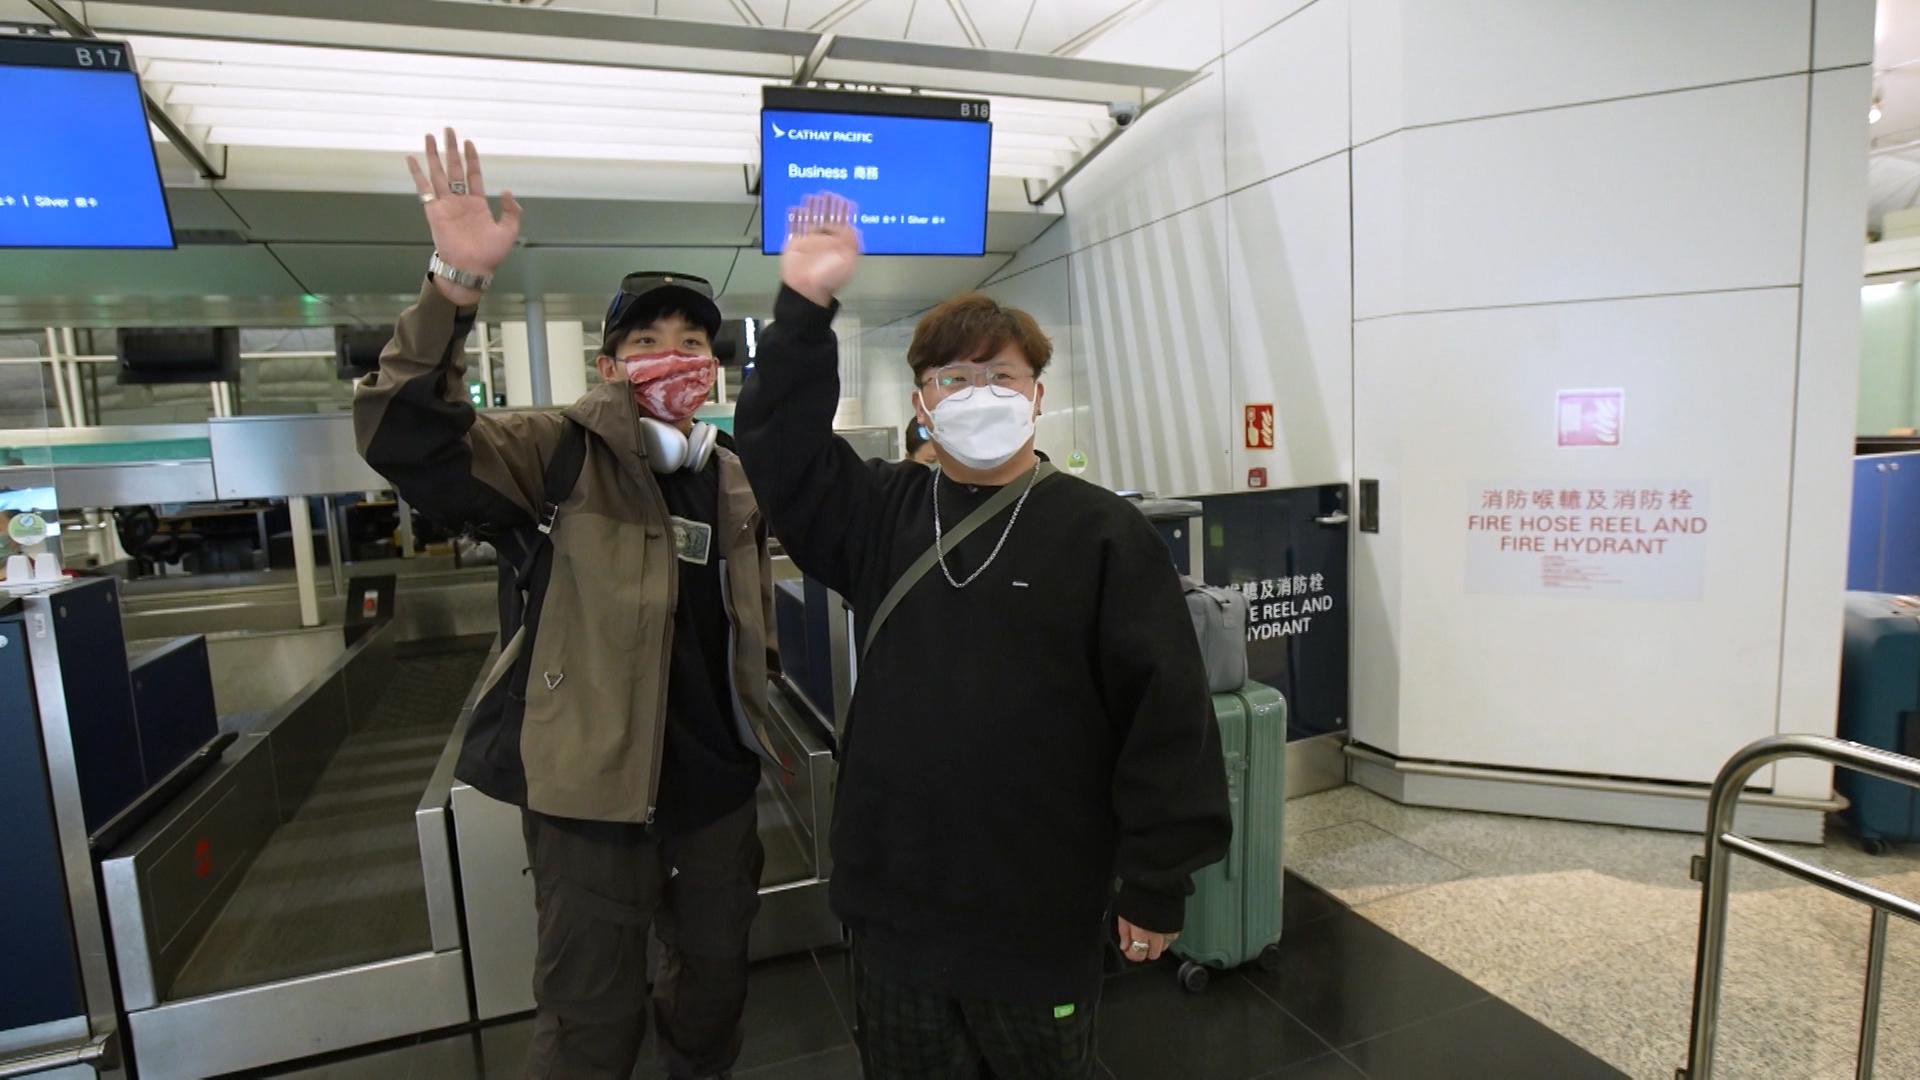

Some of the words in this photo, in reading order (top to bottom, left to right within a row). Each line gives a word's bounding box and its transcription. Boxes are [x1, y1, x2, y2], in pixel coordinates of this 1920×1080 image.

[76, 47, 121, 67] B17
[960, 103, 989, 118] B18
[788, 129, 832, 141] CATHAY
[833, 131, 873, 144] PACIFIC
[788, 162, 848, 180] Business
[1468, 515, 1512, 532] FIRE
[1520, 515, 1583, 533] HOSE
[1589, 516, 1647, 534] REEL
[1652, 516, 1708, 535] AND
[1500, 535, 1545, 552] FIRE
[1553, 537, 1669, 555] HYDRANT
[1263, 602, 1299, 620] REEL
[1301, 594, 1333, 613] AND
